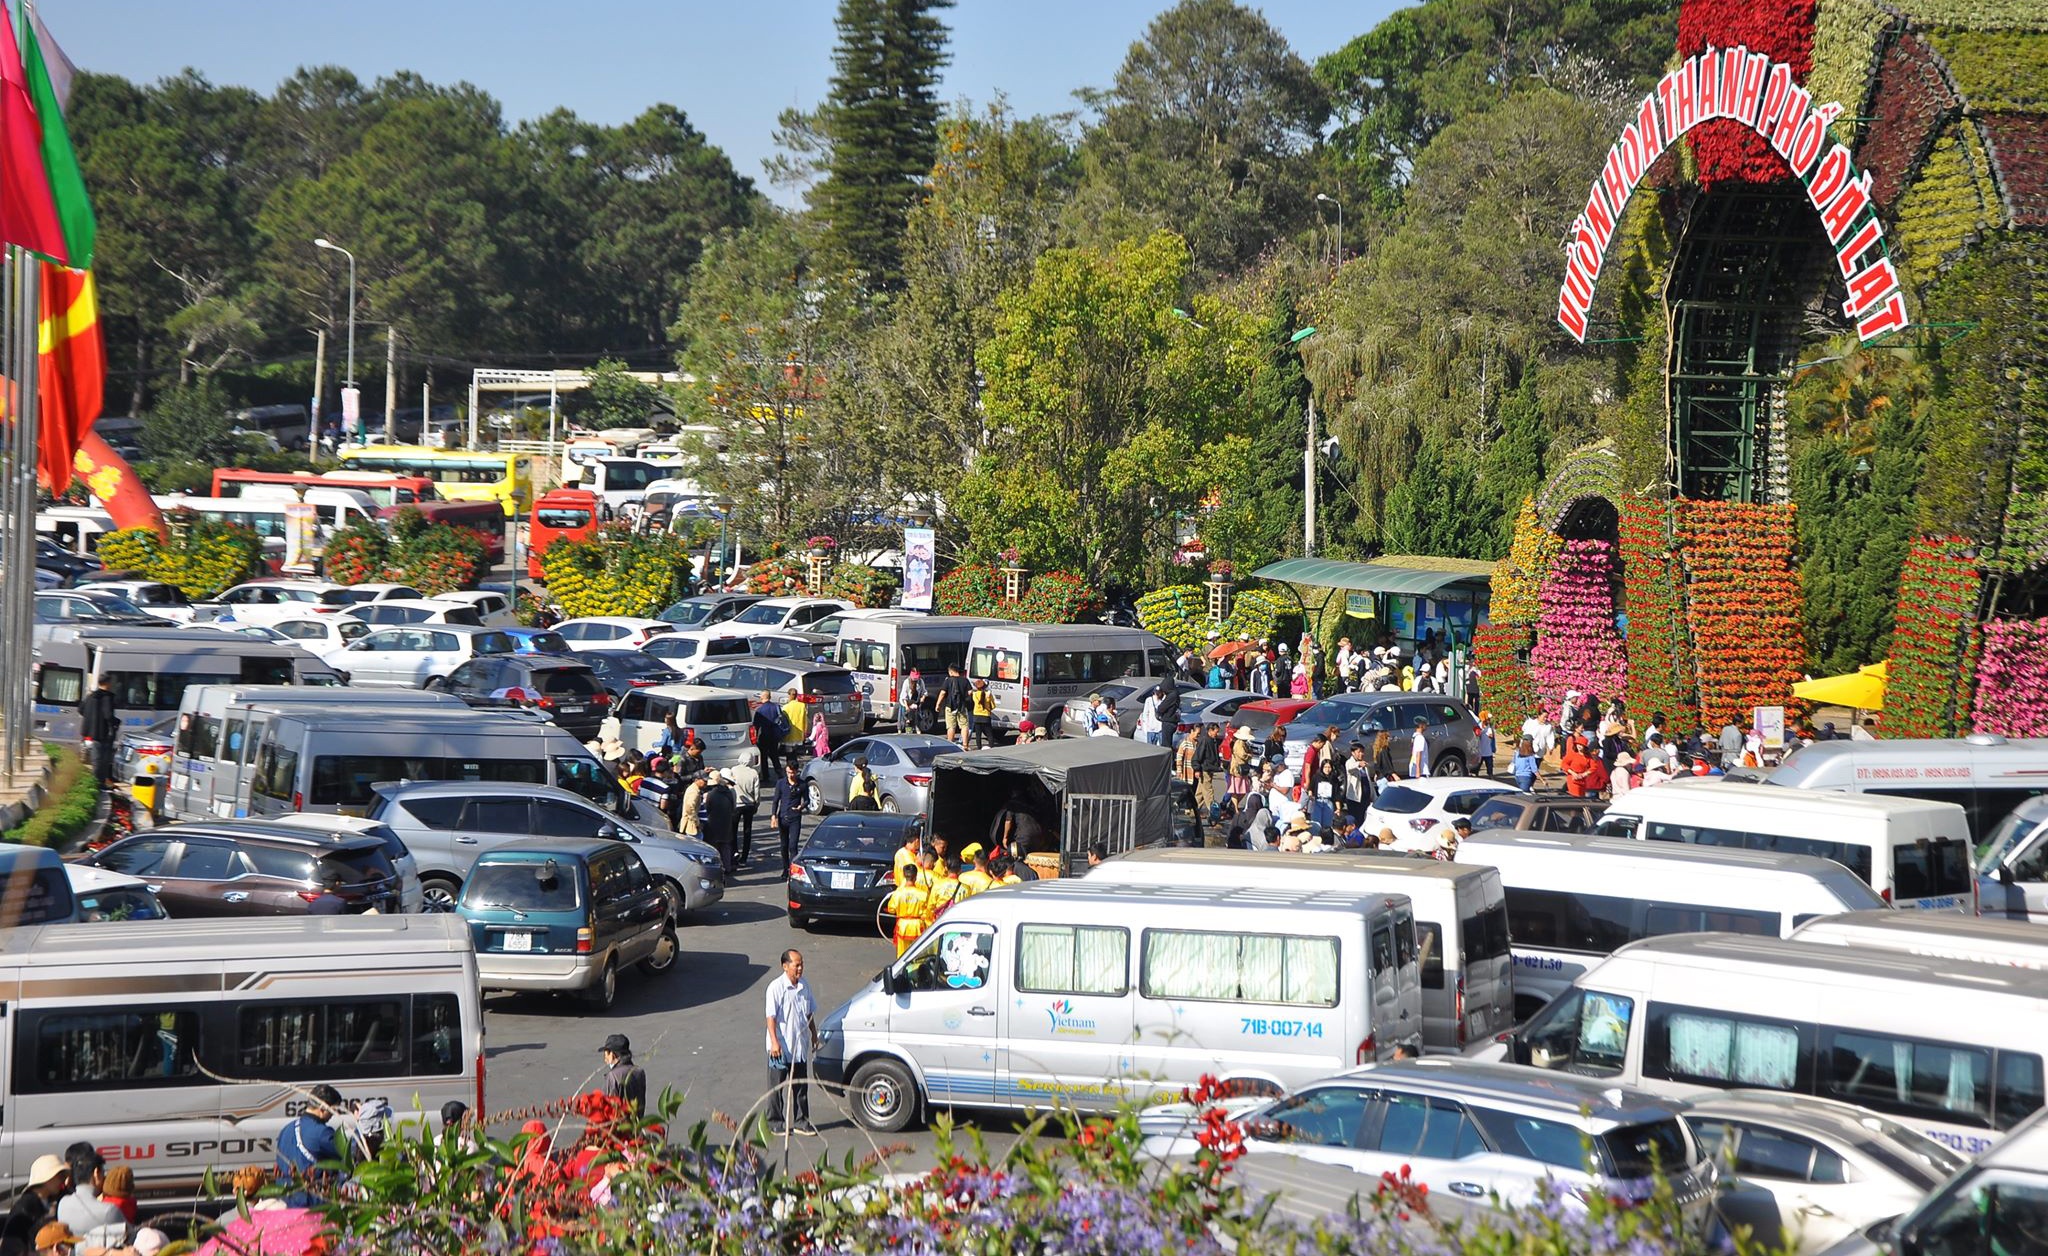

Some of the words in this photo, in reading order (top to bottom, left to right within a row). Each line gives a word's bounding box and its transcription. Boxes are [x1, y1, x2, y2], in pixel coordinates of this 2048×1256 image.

[1657, 43, 1769, 145] THÀNH
[1756, 63, 1844, 178] PHỐ
[1602, 93, 1664, 218] HOA
[1807, 143, 1874, 245] ĐÀ
[1557, 180, 1617, 343] VƯỜN
[1837, 217, 1909, 341] LẠT
[97, 1144, 155, 1161] EW
[165, 1137, 272, 1158] SPOR
